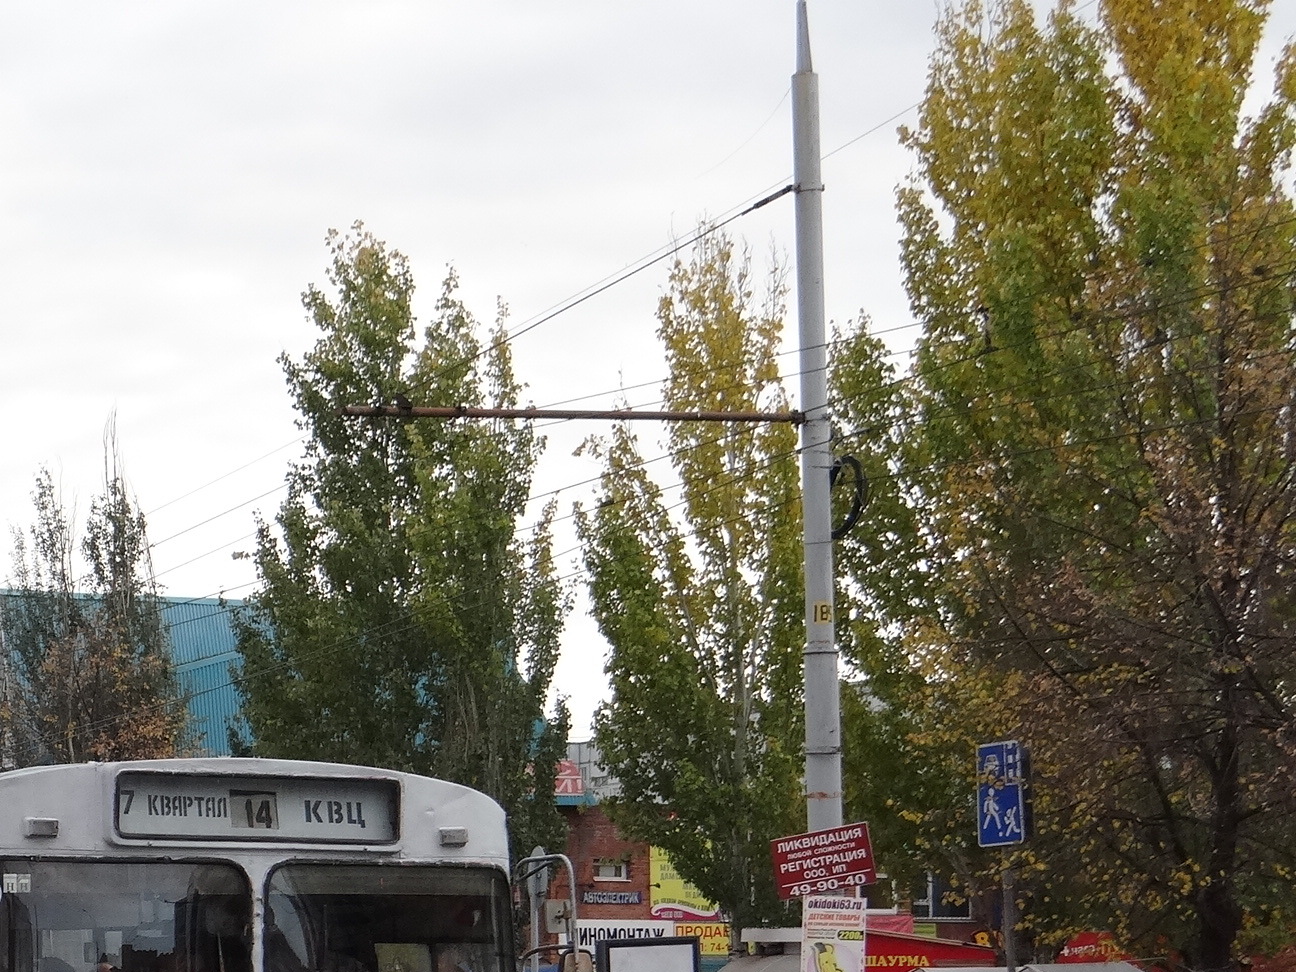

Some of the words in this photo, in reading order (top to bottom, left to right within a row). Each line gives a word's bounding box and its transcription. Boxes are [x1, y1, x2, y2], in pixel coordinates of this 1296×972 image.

[120, 790, 135, 815] 7
[147, 794, 228, 818] КВАРТАЛ
[244, 797, 273, 829] 14
[304, 799, 366, 829] КВЦ
[777, 827, 862, 854] ЛИКВИДАЦИЯ
[779, 848, 867, 874] РЕГИСТРАЦИЯ
[832, 863, 847, 875] ИП
[789, 873, 867, 897] 49-90-40
[582, 891, 640, 905] АВТОЭЛЕКТРИК
[807, 899, 863, 910] okidoki63.ru
[578, 927, 665, 946] ИНОМОНТАЖ
[675, 925, 730, 939] ПРОДАЕ
[864, 955, 930, 967] ШАУРМА
